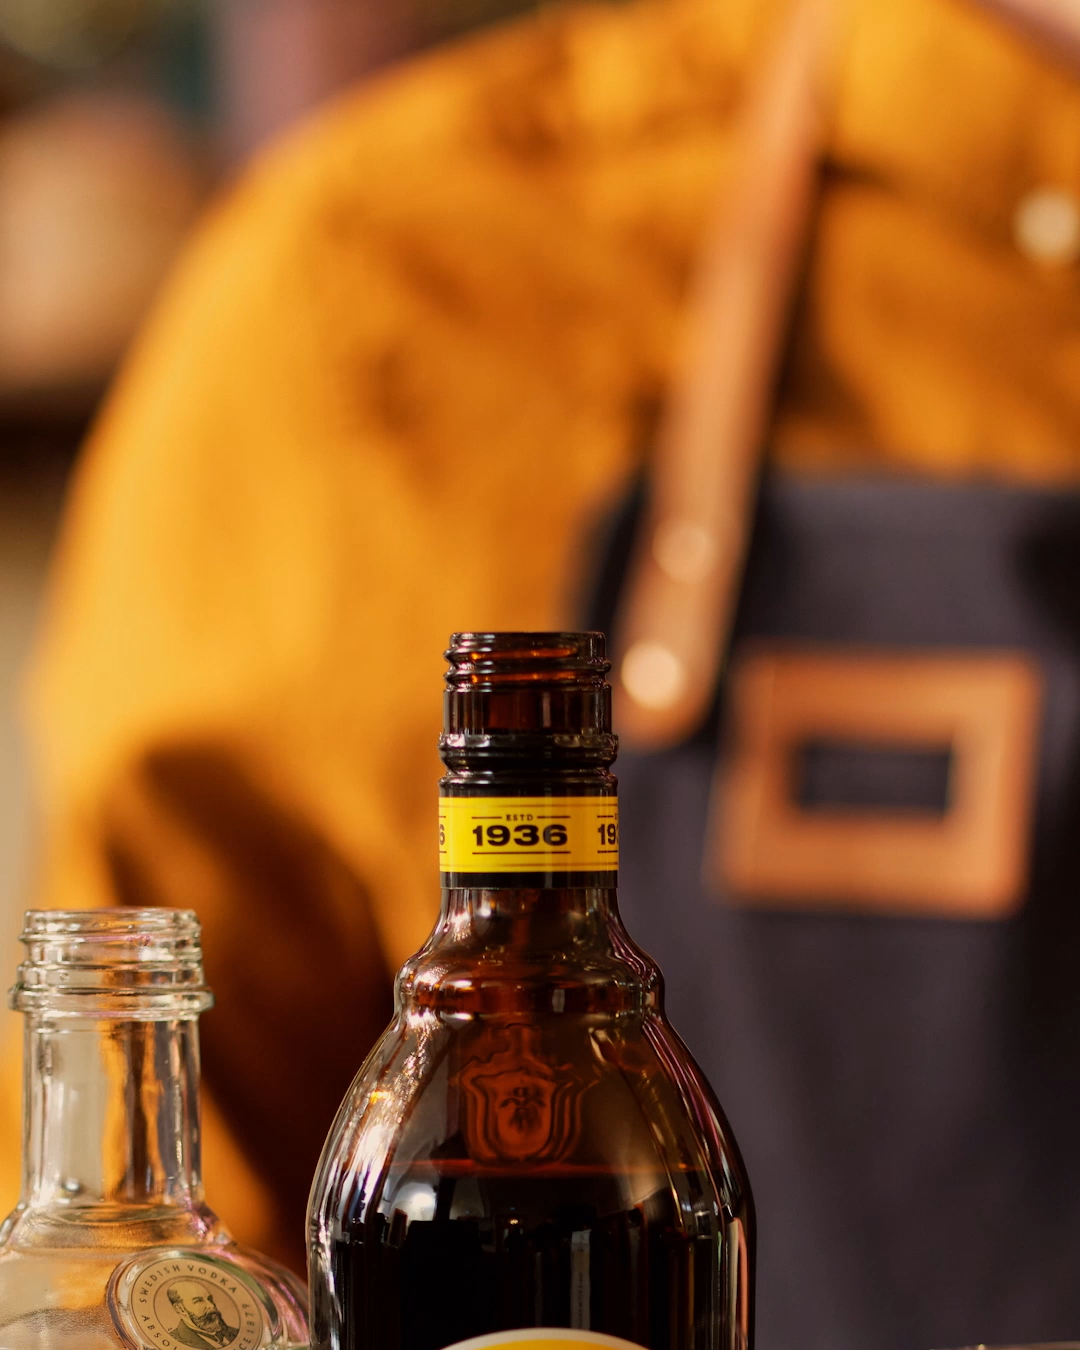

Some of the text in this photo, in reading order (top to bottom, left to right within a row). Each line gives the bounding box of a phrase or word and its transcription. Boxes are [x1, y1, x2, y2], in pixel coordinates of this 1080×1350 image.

[506, 813, 534, 822] ESTD
[472, 824, 568, 847] 1936
[597, 823, 618, 845] 19
[139, 1264, 238, 1304] SWEDISH VODKA
[242, 1302, 256, 1335] 1879
